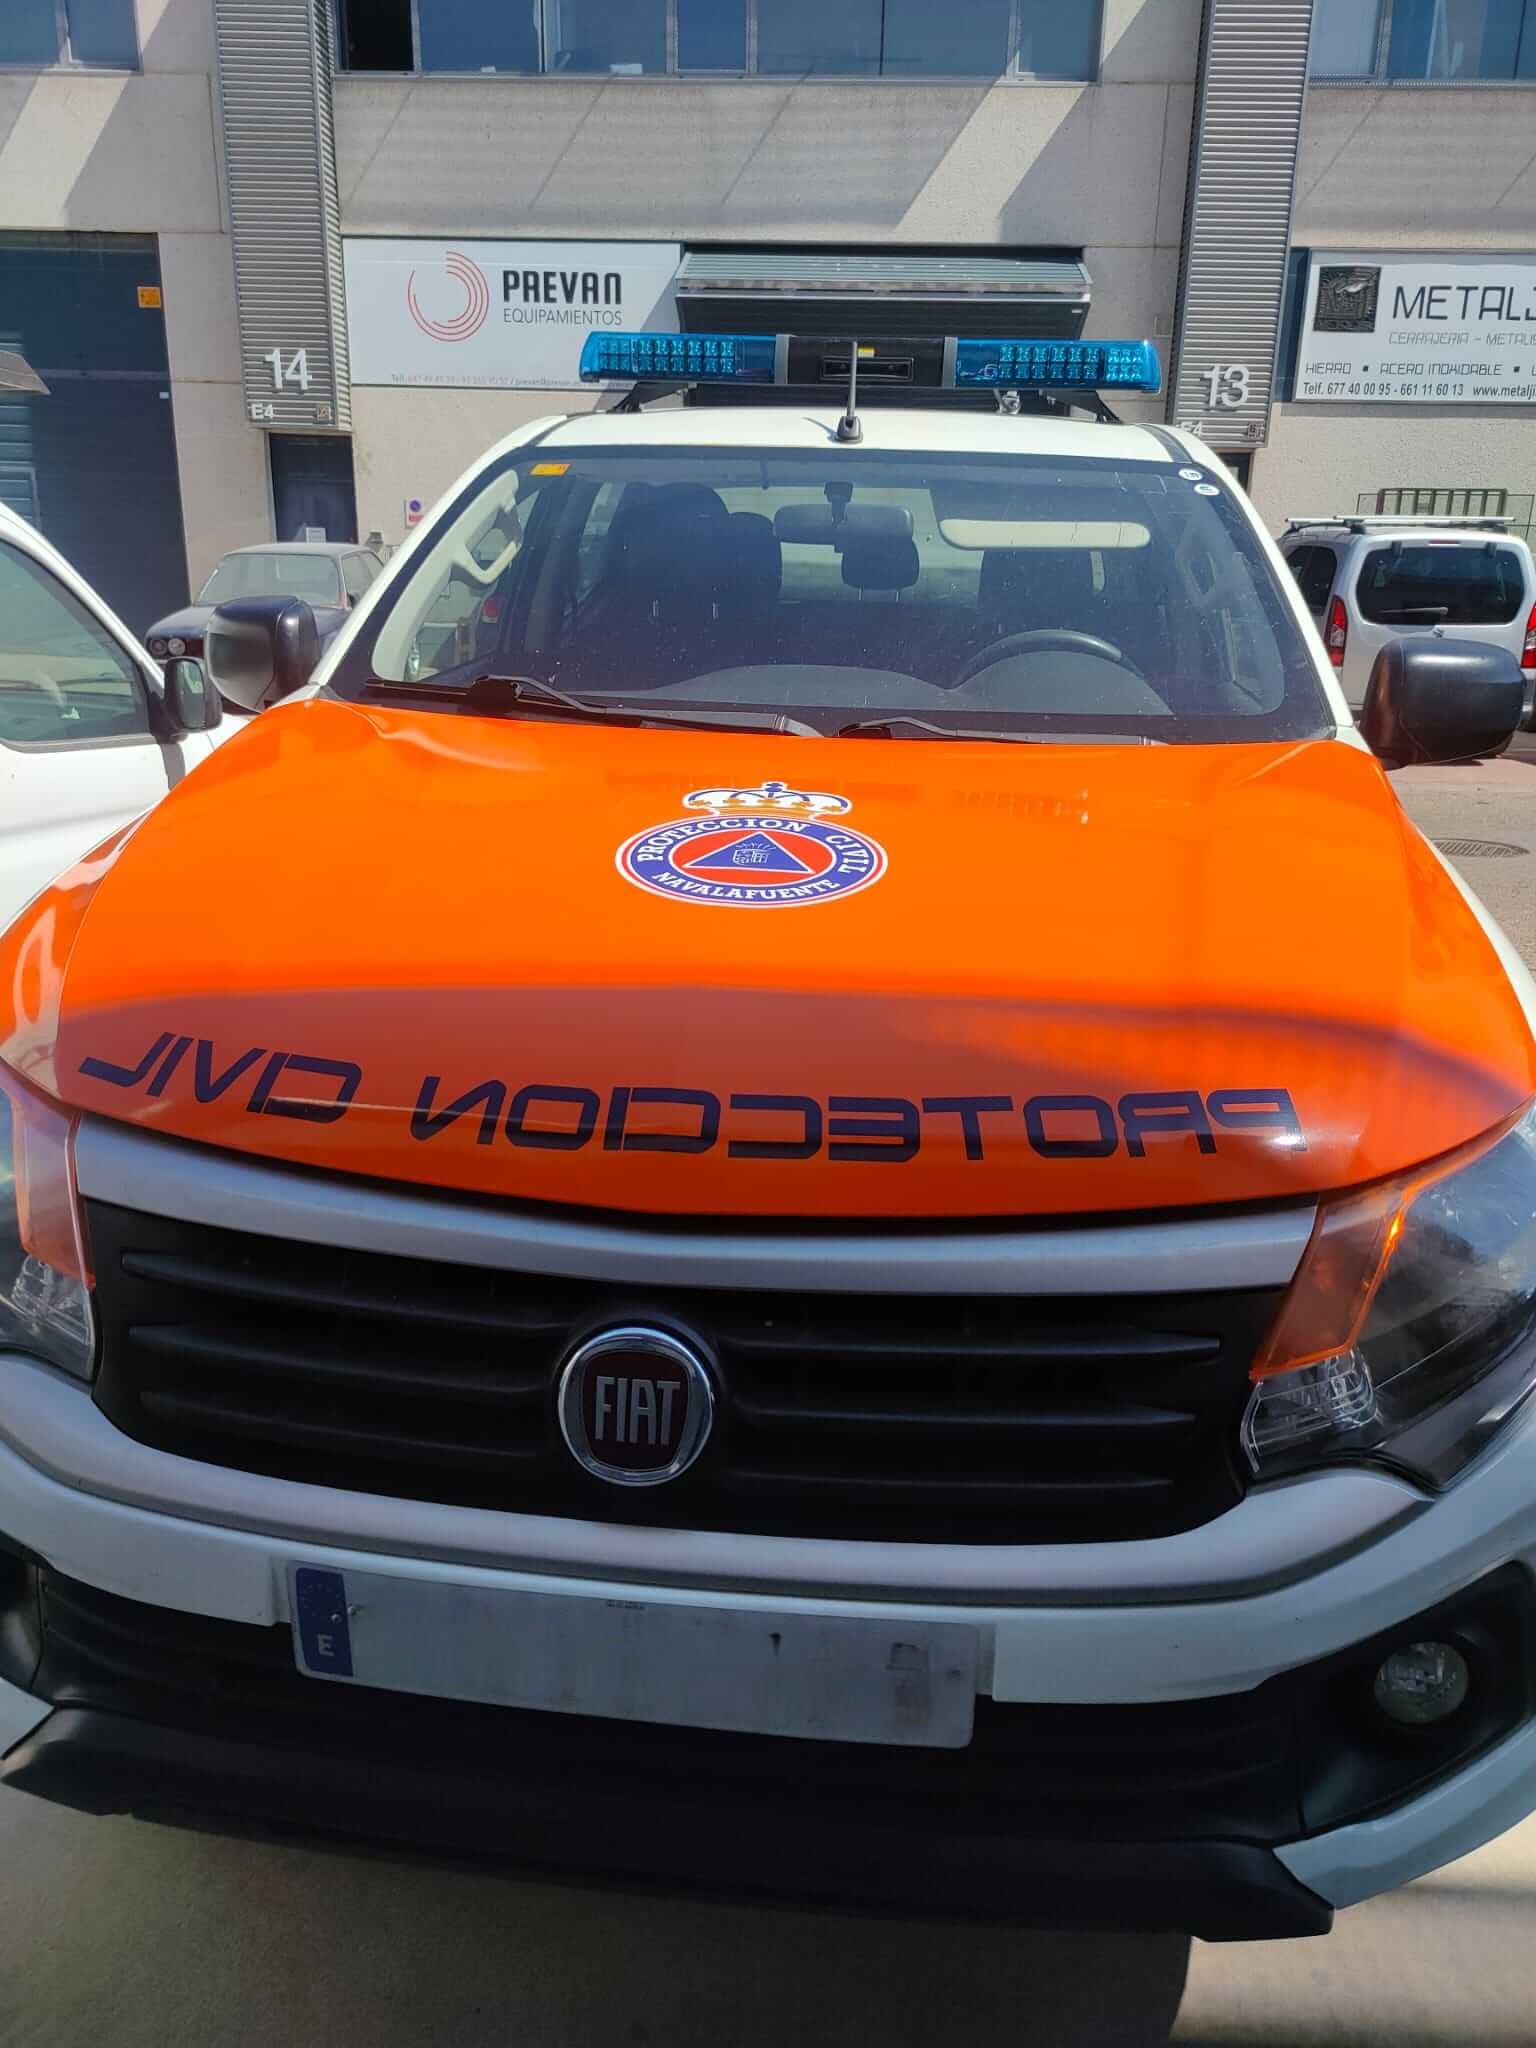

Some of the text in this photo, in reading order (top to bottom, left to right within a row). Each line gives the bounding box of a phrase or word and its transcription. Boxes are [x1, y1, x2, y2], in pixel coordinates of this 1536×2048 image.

[503, 270, 622, 305] PREVAN
[503, 308, 623, 326] EQUIPAMIENTOS
[1388, 331, 1470, 345] CERRAJERIA
[264, 348, 313, 391] 14
[1305, 362, 1352, 375] HIERRO
[1380, 363, 1424, 376] ACERO
[1428, 363, 1504, 376] INOXIDABLE
[1203, 365, 1251, 408] 13
[1303, 382, 1324, 395] Telf.
[1327, 382, 1346, 395] 677
[1348, 383, 1361, 395] 40
[1363, 383, 1376, 395] 00
[1378, 383, 1391, 396] 95
[1400, 383, 1418, 397] 661
[1422, 384, 1433, 396] 11
[1435, 384, 1449, 396] 60
[1452, 384, 1464, 396] 13
[251, 403, 274, 419] E4
[637, 818, 870, 875] PROTECCION CIVIL
[650, 871, 841, 900] NAVALAFUENTE
[594, 1375, 681, 1445] FIAT
[317, 1632, 335, 1657] E
